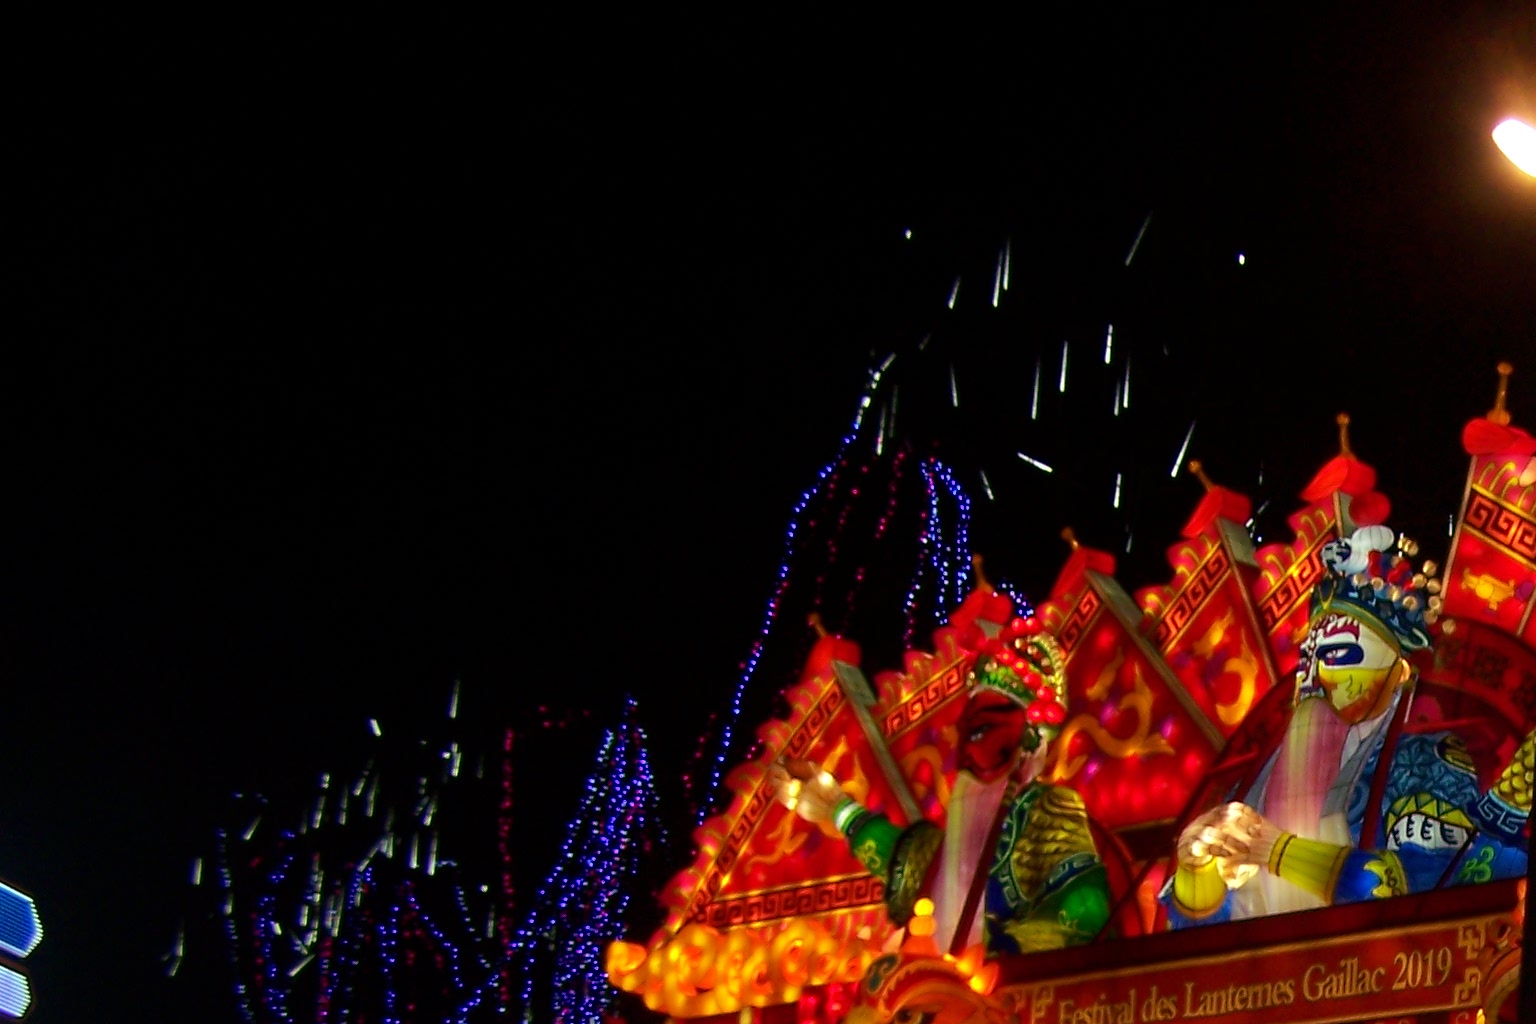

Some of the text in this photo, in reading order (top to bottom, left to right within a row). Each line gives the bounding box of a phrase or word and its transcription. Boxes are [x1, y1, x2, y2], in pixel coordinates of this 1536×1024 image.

[1142, 984, 1177, 1022] des
[1183, 974, 1295, 1019] Lanternes
[1302, 954, 1385, 1002] Gaillac
[1392, 947, 1453, 992] 2019
